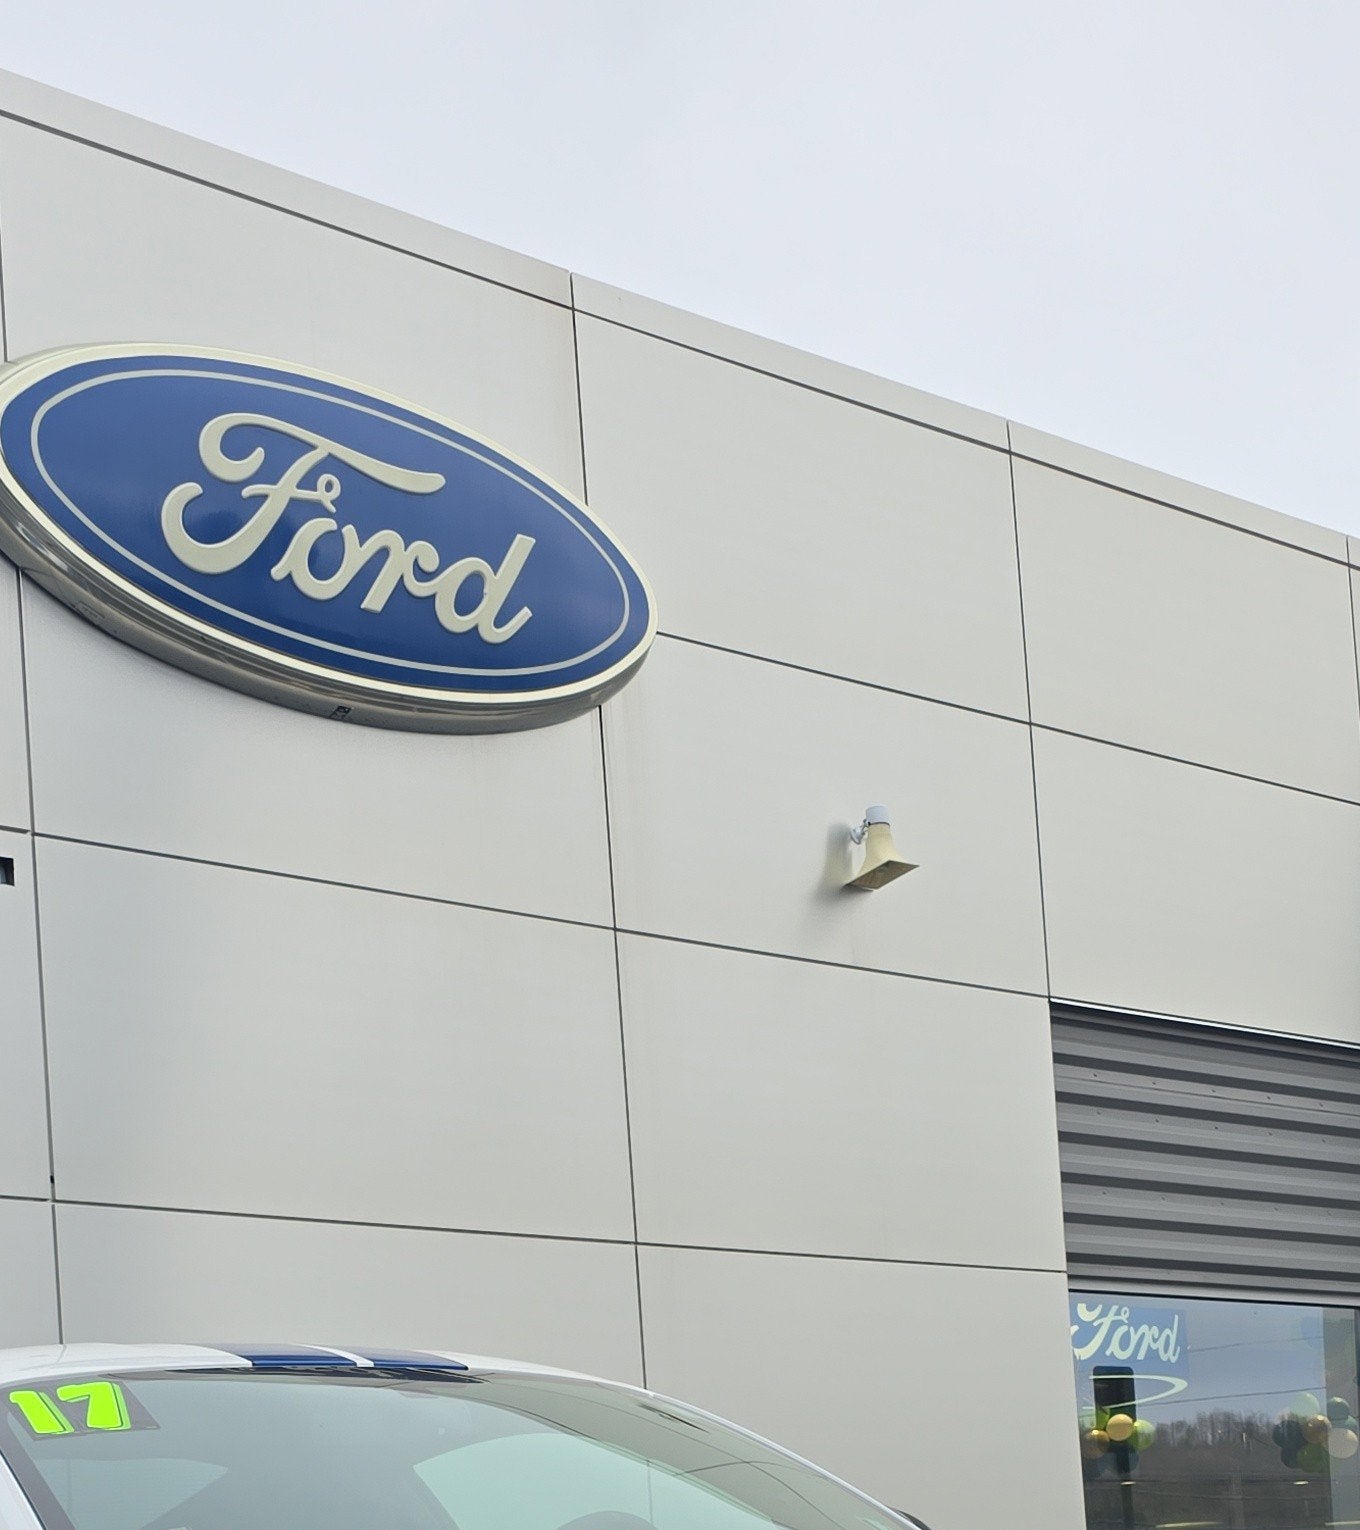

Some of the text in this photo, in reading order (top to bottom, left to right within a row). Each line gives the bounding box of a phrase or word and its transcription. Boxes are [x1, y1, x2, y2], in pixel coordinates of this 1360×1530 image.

[161, 413, 536, 645] Ford
[1071, 1302, 1181, 1363] Ford
[9, 1381, 132, 1434] 17
